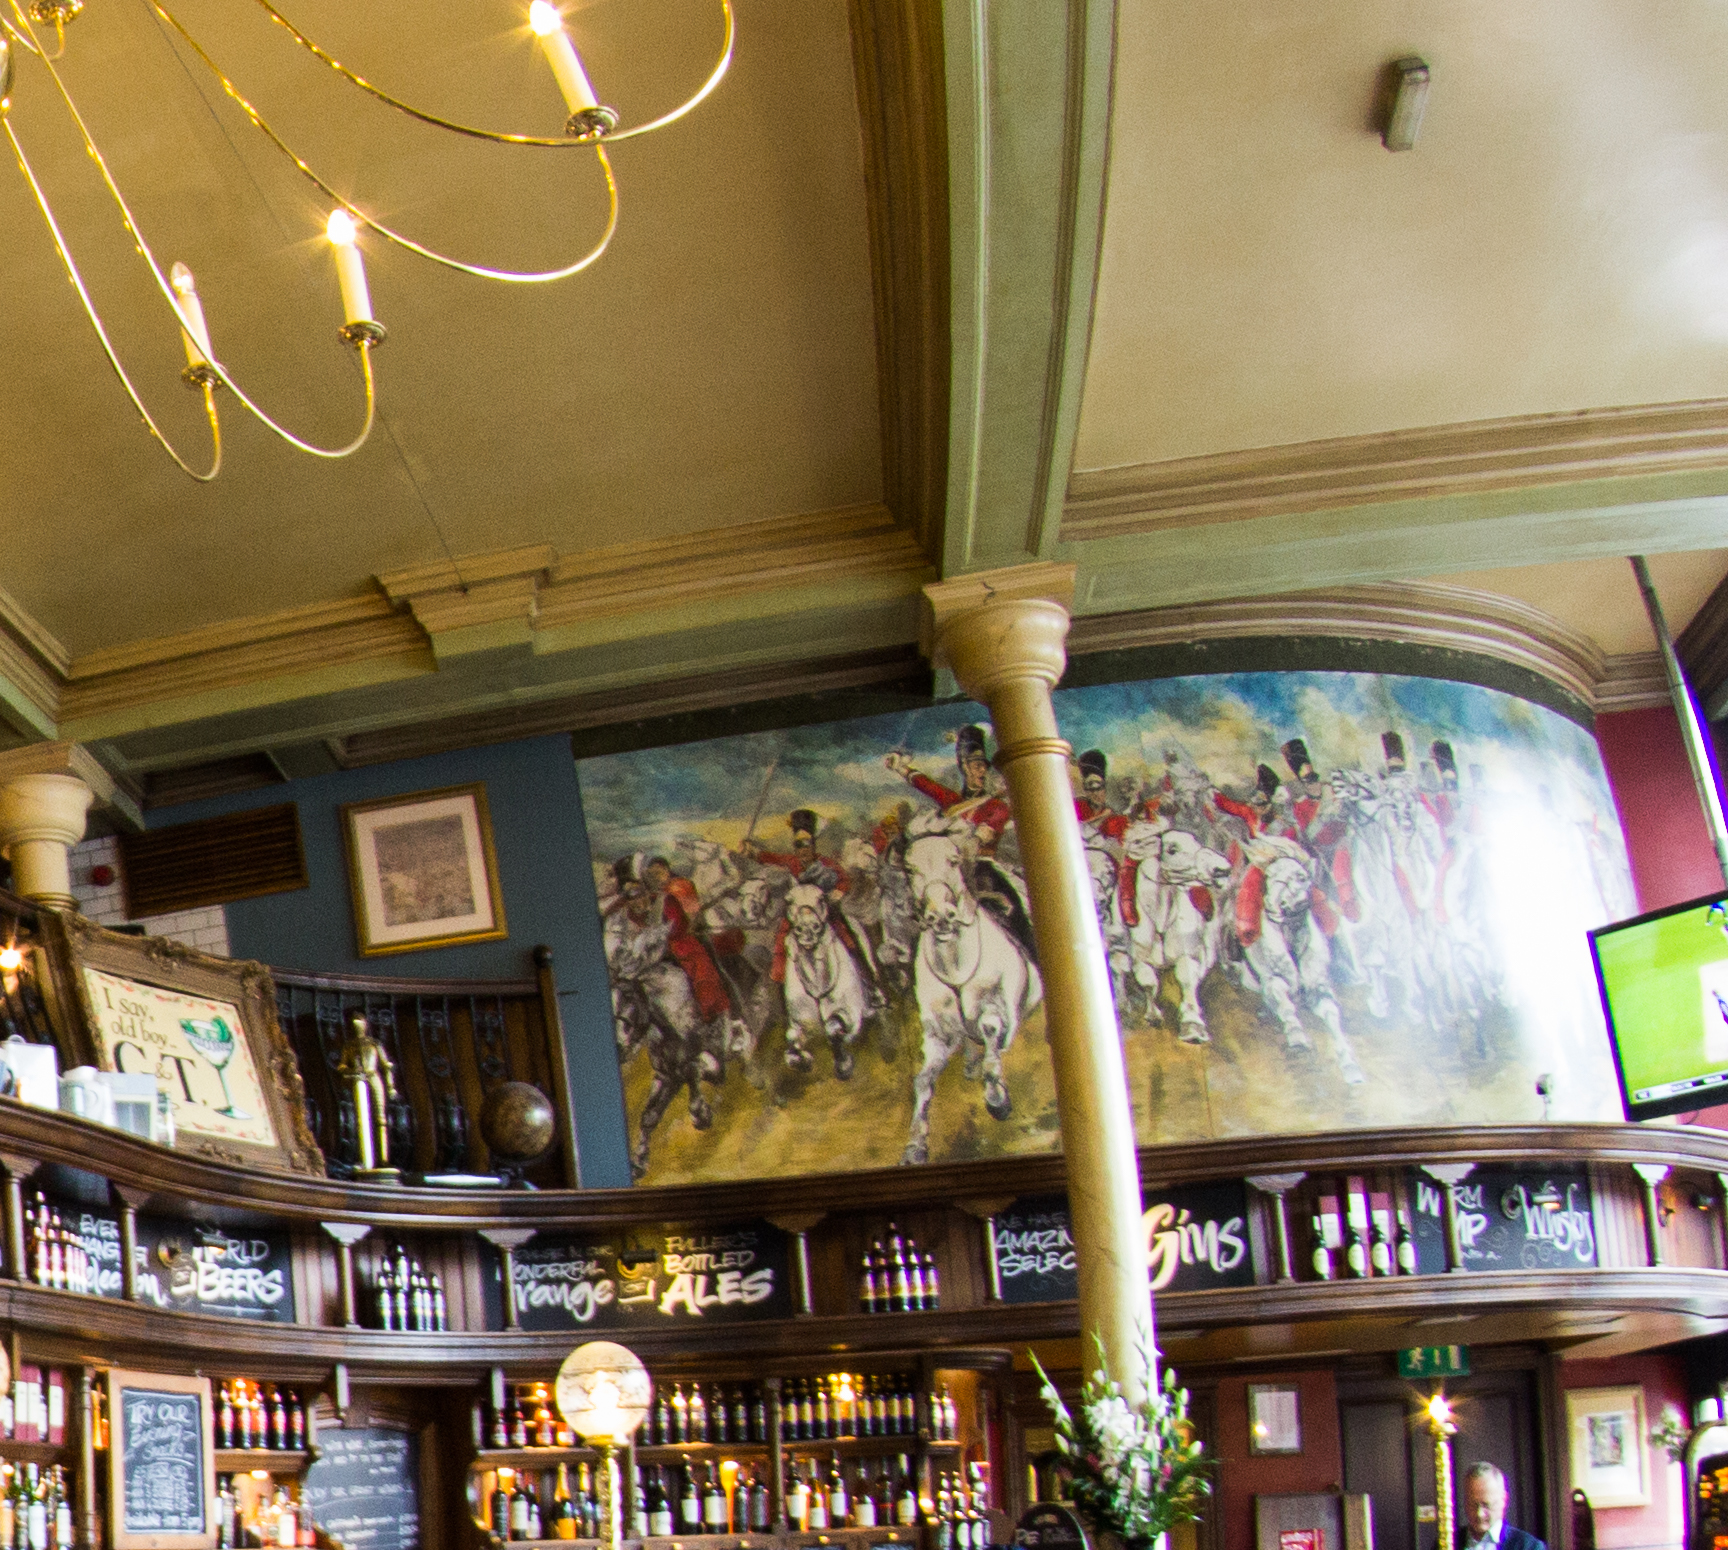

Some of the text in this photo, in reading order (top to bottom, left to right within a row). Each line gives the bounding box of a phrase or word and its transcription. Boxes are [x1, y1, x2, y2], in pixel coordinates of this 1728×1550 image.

[102, 987, 155, 1022] I say,
[111, 1015, 138, 1039] old
[155, 1062, 173, 1081] &
[663, 1250, 755, 1275] BOTTLED
[1142, 1203, 1246, 1291] Gins
[196, 1262, 285, 1304] BEERS
[515, 1279, 616, 1322] range
[658, 1268, 775, 1316] ALES
[157, 1403, 190, 1424] OUR
